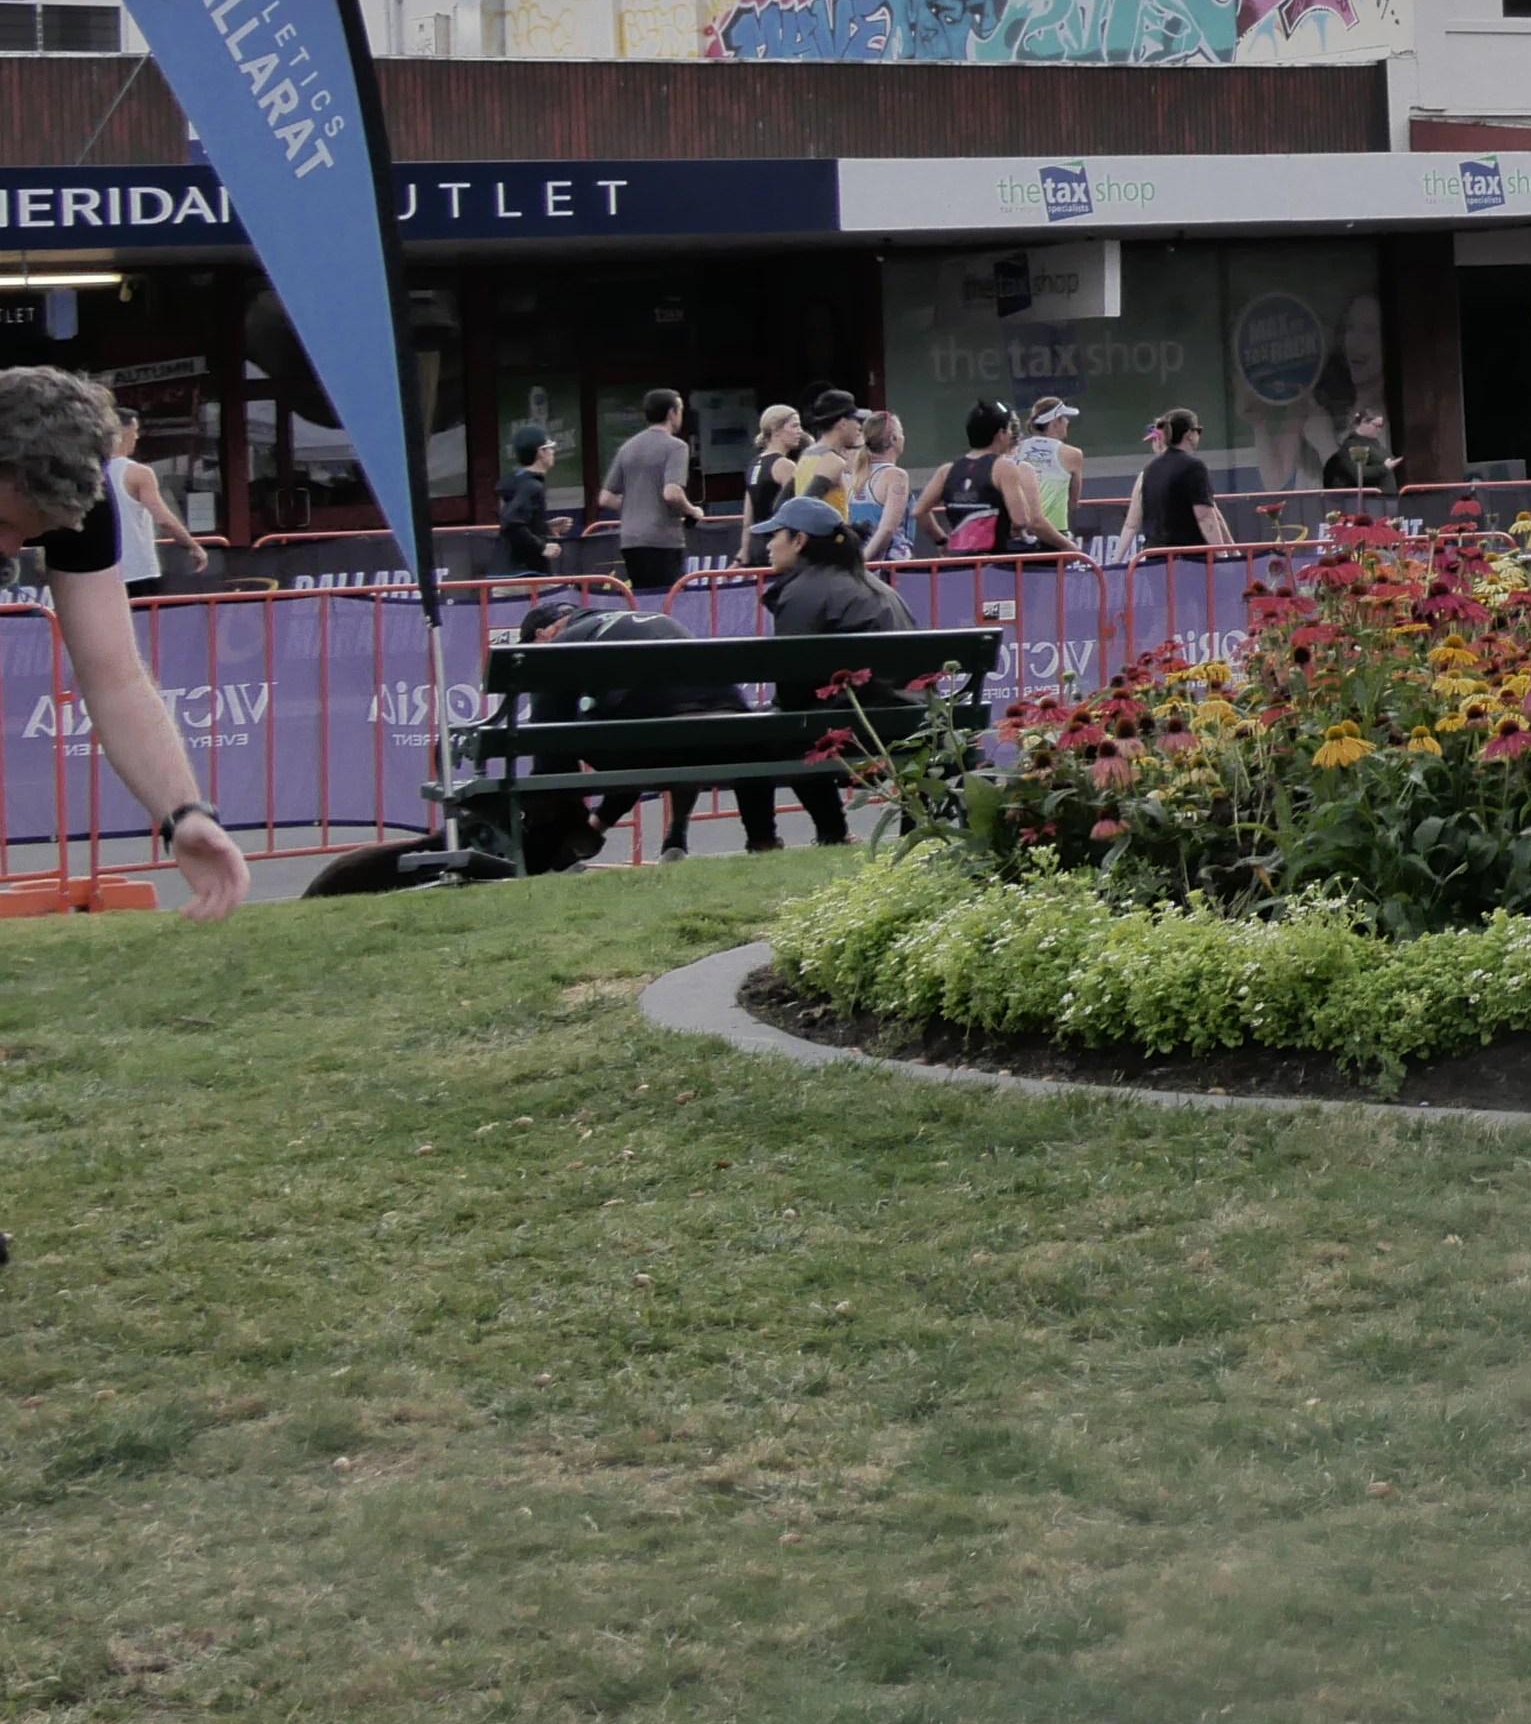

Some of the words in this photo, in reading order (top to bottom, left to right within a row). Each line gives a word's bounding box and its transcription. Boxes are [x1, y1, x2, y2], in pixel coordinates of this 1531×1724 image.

[997, 174, 1041, 203] the
[1042, 176, 1089, 204] tax
[1095, 173, 1156, 208] shop
[1422, 169, 1460, 196] the
[1461, 171, 1502, 196] tax
[0, 187, 230, 228] ERIDA
[1047, 204, 1091, 215] specialists
[1032, 267, 1080, 299] shop
[931, 337, 998, 383] the
[1007, 339, 1079, 379] tax
[1086, 335, 1185, 383] shop
